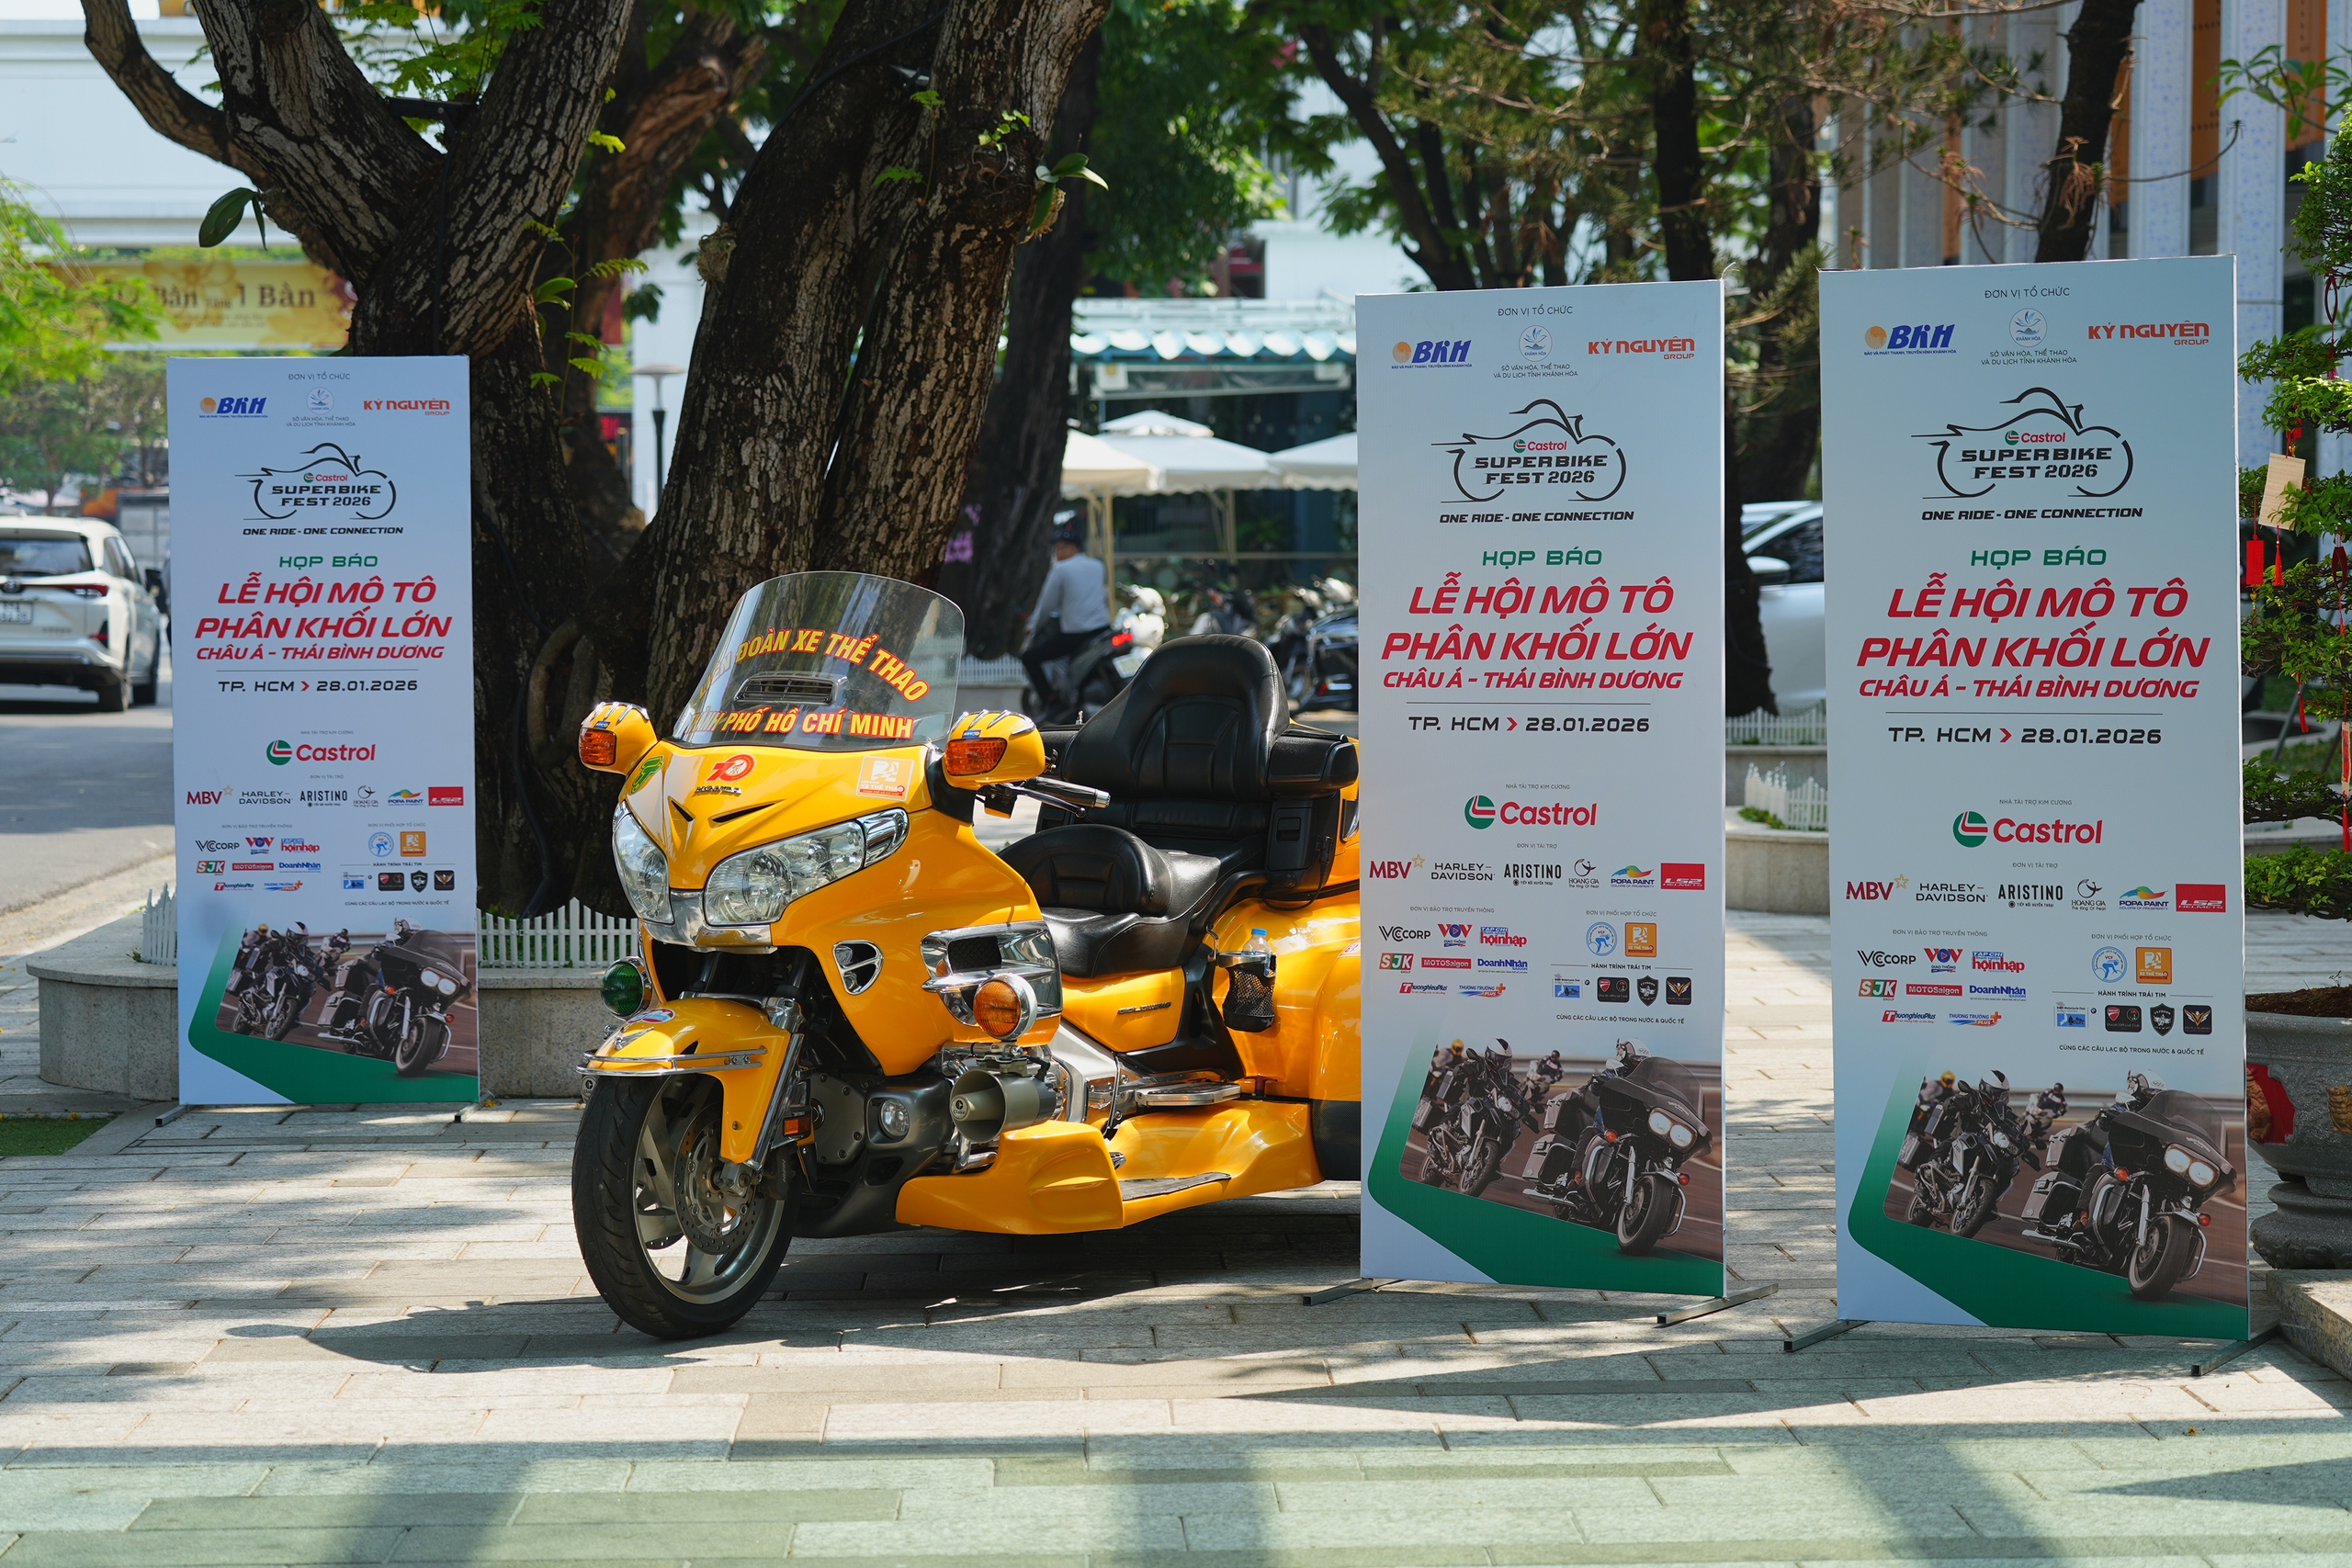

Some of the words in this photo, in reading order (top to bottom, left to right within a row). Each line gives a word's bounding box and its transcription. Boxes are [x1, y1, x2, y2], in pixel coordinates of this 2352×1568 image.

[257, 282, 316, 308] Bàn
[1984, 288, 2007, 299] ĐƠN
[2010, 289, 2020, 299] VỊ
[2023, 285, 2038, 297] TỔ
[2041, 286, 2070, 297] CHỨC
[1887, 323, 1955, 349] BKH
[2120, 320, 2210, 339] NGUYÊN
[1410, 340, 1471, 364] BKH
[1615, 336, 1694, 354] NGUYÊN
[216, 397, 267, 415] BKH
[387, 398, 451, 411] NGUYÊN
[1527, 440, 1567, 452] Castrol
[2020, 432, 2066, 444] Castrol
[1473, 455, 1609, 469] SUPERBIKE
[1960, 447, 2113, 463] SUPERBIKE
[315, 473, 348, 482] Castrol
[1484, 472, 1545, 485] FEST
[1548, 470, 1596, 484] 2026
[1972, 466, 2041, 479] FEST
[2044, 464, 2098, 479] 2026
[270, 485, 382, 495] SUPERBIKE
[279, 497, 331, 507] FEST
[333, 496, 372, 506] 2026
[1439, 514, 1469, 524] ONE
[1471, 513, 1505, 523] RIDE
[1511, 513, 1543, 522] ONE
[1544, 511, 1635, 522] CONNECTION
[1921, 511, 1954, 521] ONE
[1958, 510, 1996, 520] RIDE
[2004, 509, 2038, 520] ONE
[2041, 508, 2143, 519] CONNECTION
[330, 526, 404, 535] CONNECTION
[278, 556, 323, 570] HỌP
[331, 553, 379, 568] BÁO
[1482, 550, 1536, 570] HỌP
[1545, 546, 1603, 566] BÁO
[1971, 549, 2031, 570] HỌP
[2042, 545, 2108, 566] BÁO
[217, 571, 263, 604] LỄ
[263, 575, 324, 608] HỘI
[326, 575, 385, 604] MÔ
[391, 574, 437, 603] TÔ
[1408, 570, 1463, 615] LỄ
[1463, 576, 1536, 620] HỘI
[1539, 576, 1610, 614] MÔ
[1619, 575, 1675, 614] TÔ
[1887, 571, 1949, 618] LỄ
[1950, 578, 2032, 624] HỘI
[2035, 577, 2116, 618] MÔ
[2126, 577, 2189, 617] TÔ
[194, 611, 291, 639] PHÂN
[294, 605, 378, 638] KHỐI
[380, 608, 453, 637] LỚN
[1381, 623, 1497, 660] PHÂN
[1499, 616, 1601, 660] KHỐI
[1604, 622, 1694, 660] LỚN
[1856, 627, 1987, 668] PHÂN
[1991, 620, 2106, 668] KHỐI
[2109, 626, 2211, 668] LỚN
[196, 644, 248, 660] CHÂU
[249, 643, 264, 660] Á
[280, 643, 324, 660] THÁI
[326, 642, 375, 660] BÌNH
[376, 645, 446, 659] DƯƠNG
[735, 626, 792, 664] ĐOÀN
[791, 627, 825, 653] XE
[824, 632, 879, 665] THỂ
[868, 648, 930, 703] THAO
[1382, 667, 1444, 688] CHÂU
[1445, 666, 1464, 688] Á
[1483, 666, 1535, 689] THÁI
[1538, 667, 1597, 689] BÌNH
[1598, 671, 1684, 689] DƯƠNG
[1859, 674, 1928, 697] CHÂU
[1929, 673, 1950, 697] Á
[1973, 673, 2031, 698] THÁI
[2035, 674, 2101, 698] BÌNH
[2103, 678, 2200, 698] DƯƠNG
[218, 681, 246, 693] TP.
[254, 681, 295, 692] HCM
[316, 680, 418, 692] 28.01.2026
[722, 705, 772, 732] PHỐ
[763, 706, 800, 733] HỒ
[801, 707, 848, 733] CHÍ
[849, 713, 915, 739] MINH
[1408, 716, 1442, 731] TP.
[1451, 716, 1499, 731] HCM
[1524, 717, 1650, 733] 28.01.2026
[1888, 727, 1926, 742] TP.
[1936, 728, 1992, 743] HCM
[2020, 728, 2162, 745] 28.01.2026
[296, 743, 376, 761] Castrol
[187, 791, 223, 805] MBV
[300, 790, 347, 802] ARISTINO
[1499, 801, 1597, 826] Castrol
[1993, 818, 2103, 844] Castrol
[1369, 861, 1412, 879] MBV
[1430, 872, 1493, 881] DAVIDSON
[1503, 863, 1562, 879] ARISTINO
[1846, 881, 1894, 900] MBV
[1916, 893, 1986, 903] DAVIDSON
[1997, 884, 2064, 901] ARISTINO
[1380, 954, 1413, 968] SJK
[1423, 959, 1469, 968] MOTOSaigon
[1860, 980, 1896, 996] SJK
[1908, 986, 1960, 995] MOTOSaigon
